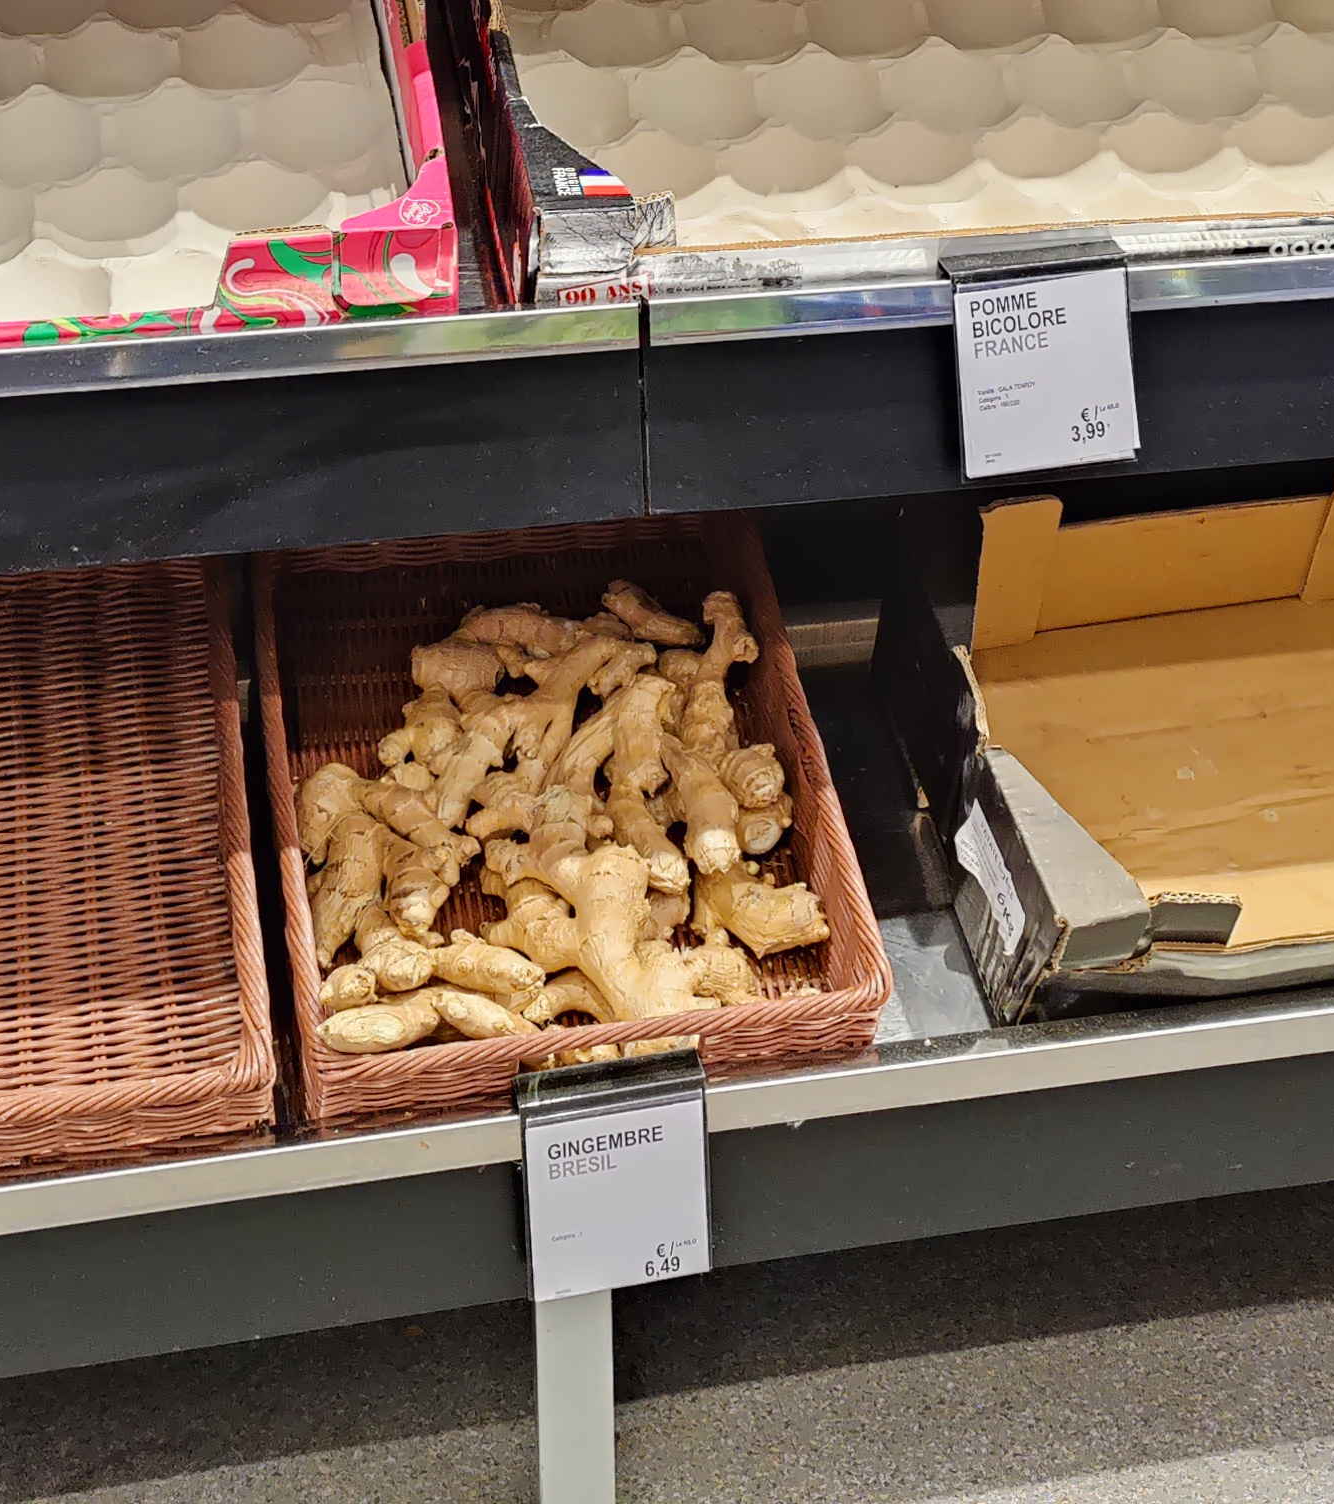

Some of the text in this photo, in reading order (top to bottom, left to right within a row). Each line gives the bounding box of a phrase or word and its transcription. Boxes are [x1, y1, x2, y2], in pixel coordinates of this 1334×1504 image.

[551, 167, 572, 197] FRANCE
[565, 167, 583, 197] ORIGINE
[565, 287, 597, 306] 90
[970, 291, 1037, 318] POMME
[972, 307, 1067, 339] BICOLORE
[973, 331, 1049, 359] FRANCE
[1071, 421, 1105, 444] 3,99
[547, 1125, 664, 1160] GINGEMBRE
[548, 1154, 618, 1180] BRESIL
[644, 1256, 680, 1278] 6,49
